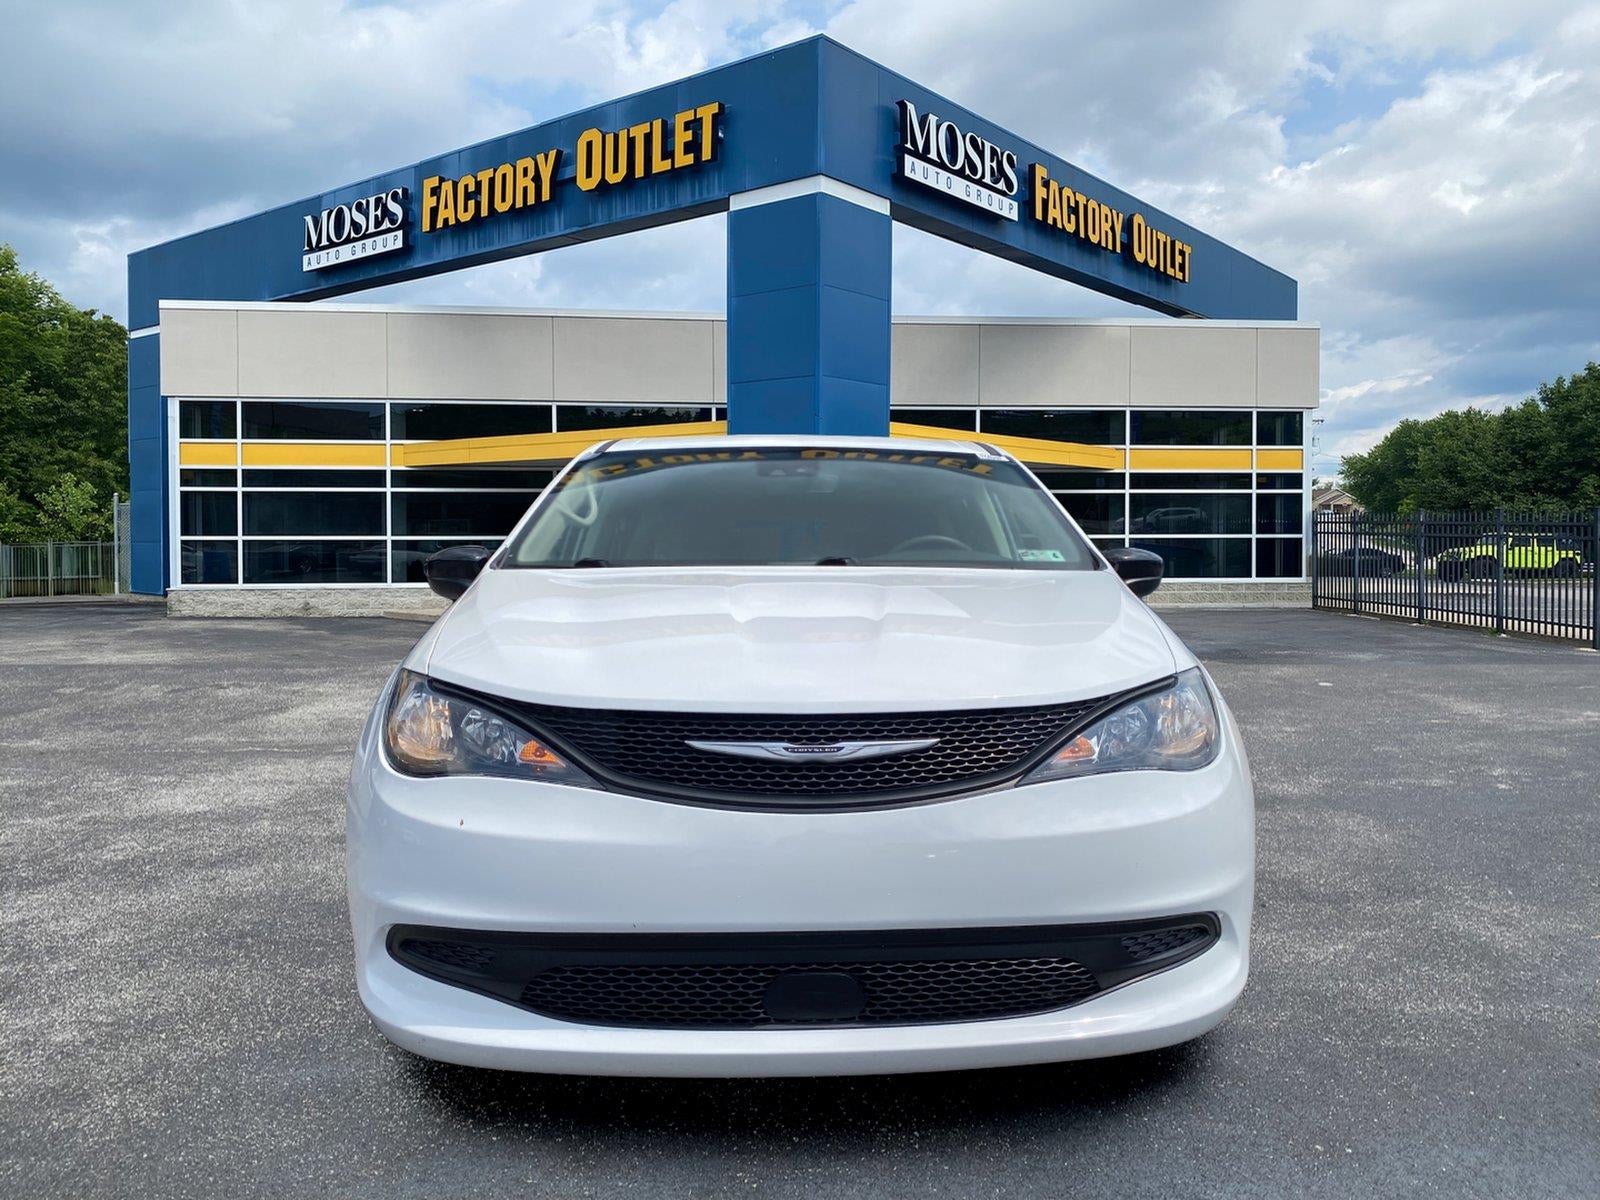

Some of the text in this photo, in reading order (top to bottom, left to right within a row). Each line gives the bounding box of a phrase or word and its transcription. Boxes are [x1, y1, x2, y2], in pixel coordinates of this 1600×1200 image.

[421, 101, 720, 233] FACTORY OUTLET
[904, 99, 1018, 196] MOSES
[909, 160, 1015, 215] AUTO GROUP
[303, 188, 404, 251] MOSES
[306, 234, 399, 268] AUTO GROUP
[1034, 163, 1192, 284] FACTORY OUTLET
